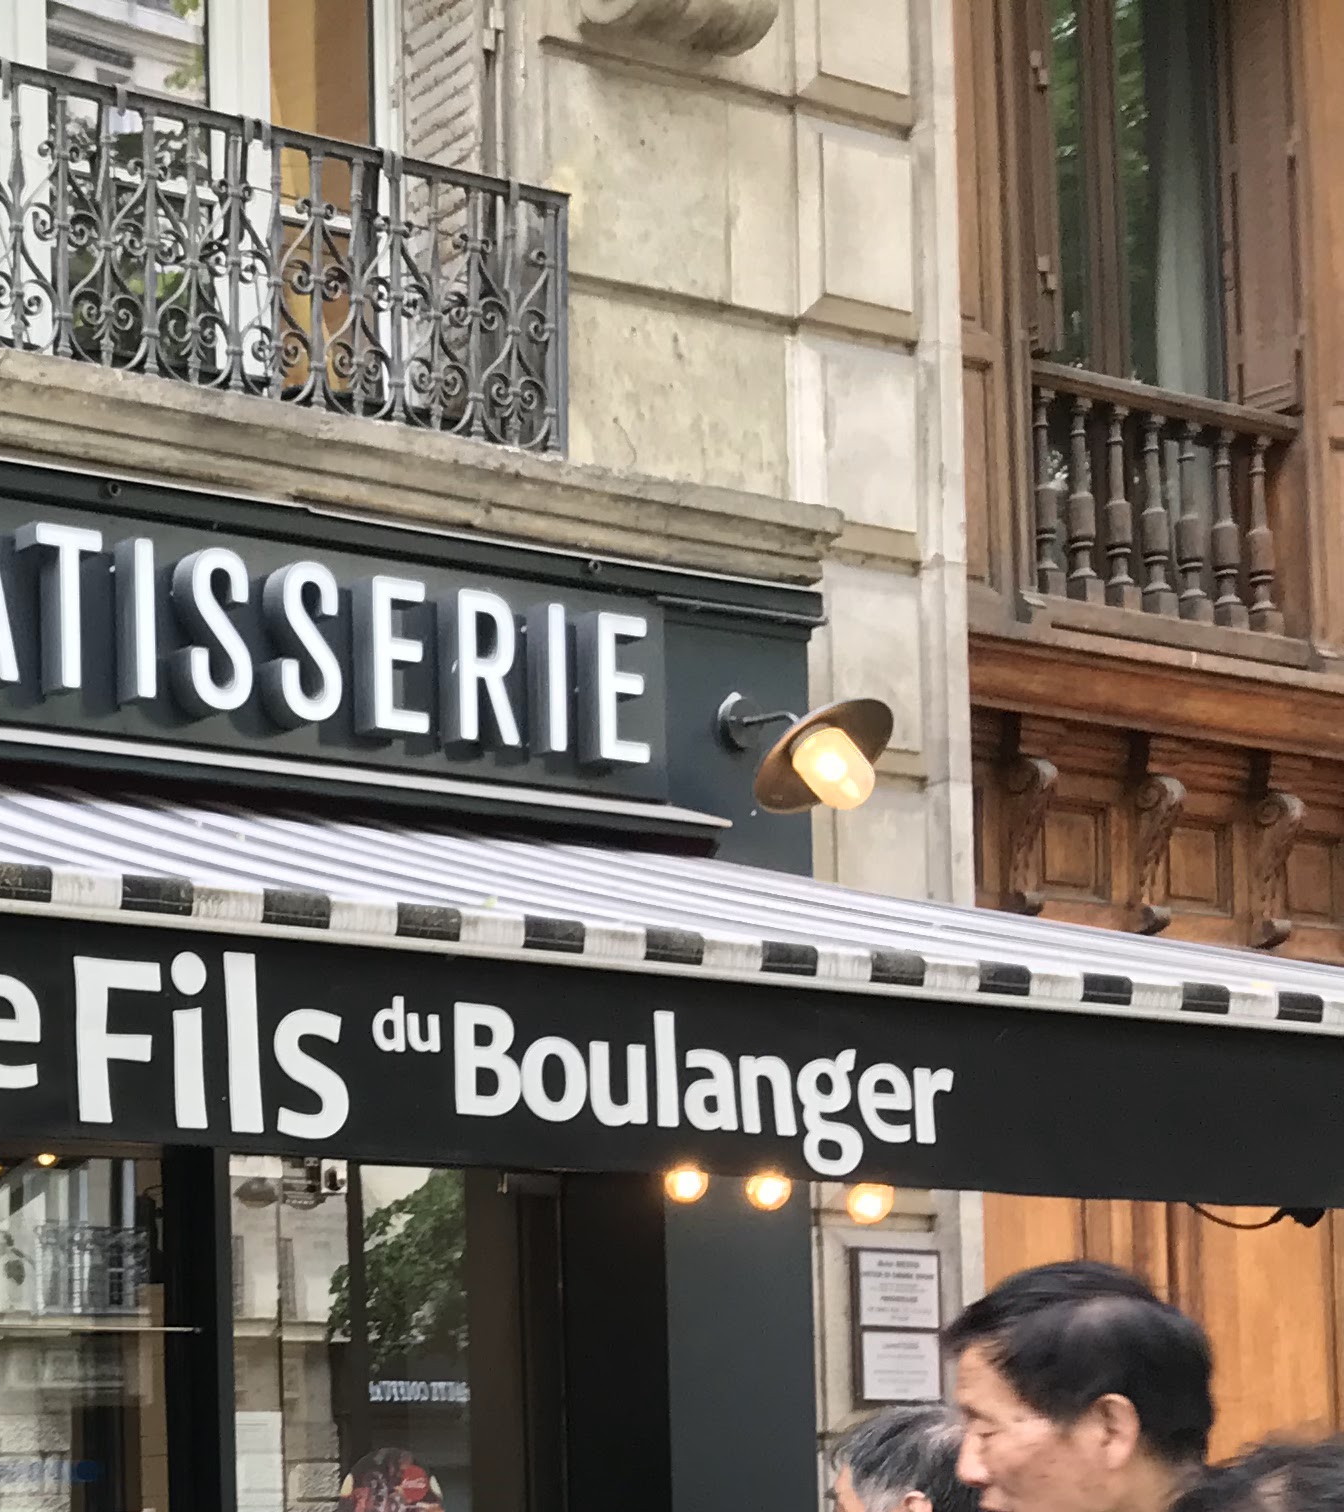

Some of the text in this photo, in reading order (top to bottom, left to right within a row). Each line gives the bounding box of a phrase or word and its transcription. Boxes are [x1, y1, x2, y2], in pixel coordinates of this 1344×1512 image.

[74, 949, 350, 1140] Fils
[370, 995, 441, 1057] du
[453, 1001, 954, 1178] Boulanger
